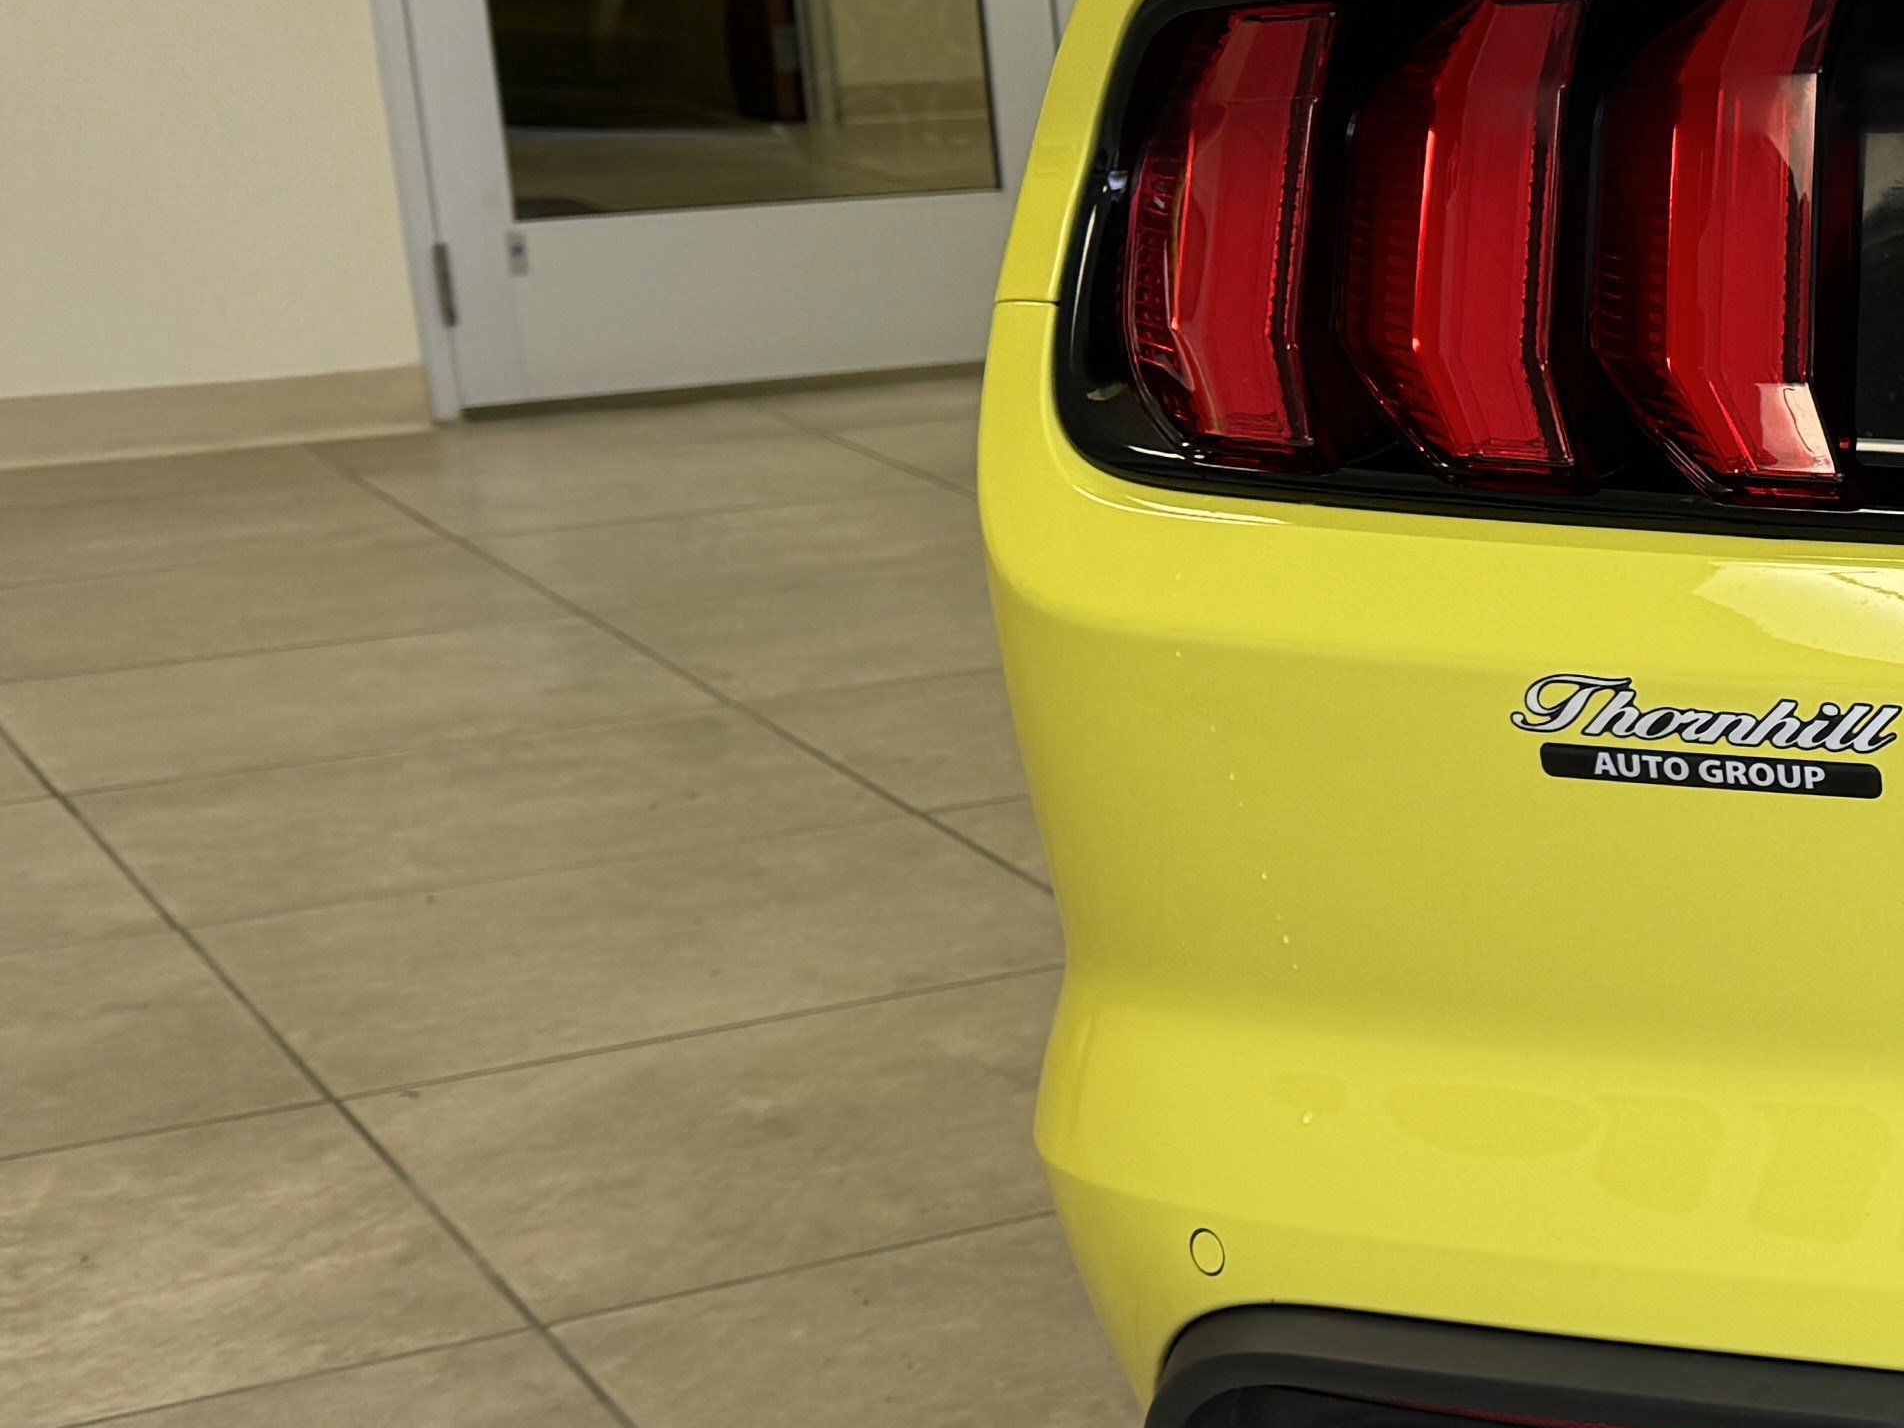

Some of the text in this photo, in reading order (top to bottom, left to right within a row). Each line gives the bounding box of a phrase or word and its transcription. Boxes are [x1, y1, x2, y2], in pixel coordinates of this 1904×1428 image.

[1510, 673, 1902, 754] Thornhill
[1594, 752, 1826, 790] AUTO GROUP
